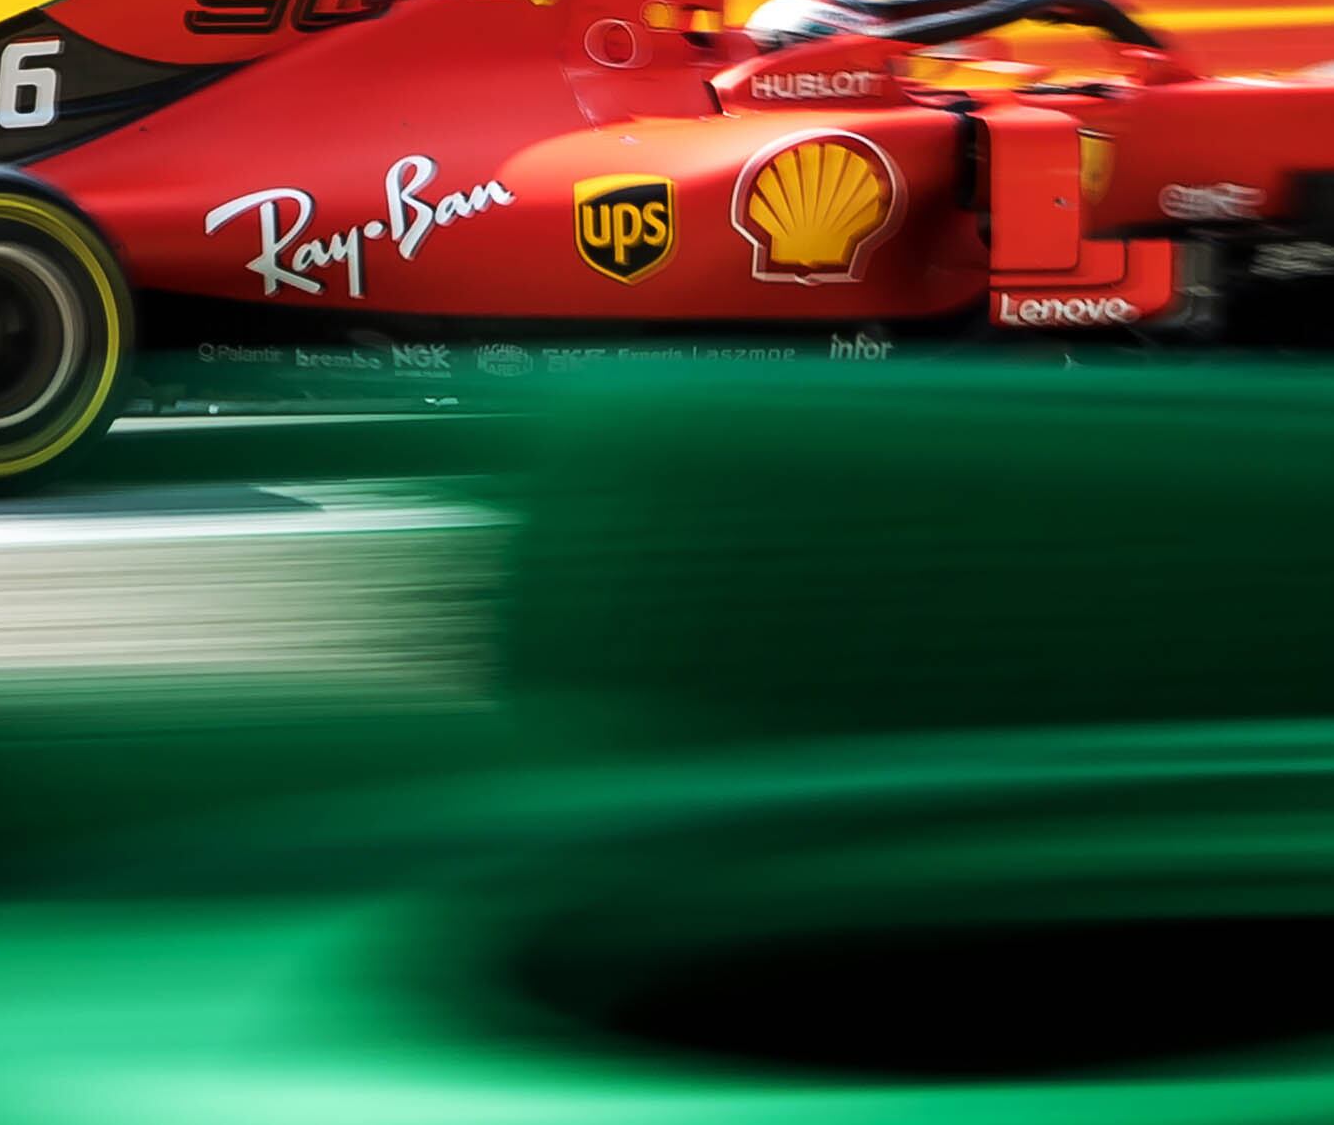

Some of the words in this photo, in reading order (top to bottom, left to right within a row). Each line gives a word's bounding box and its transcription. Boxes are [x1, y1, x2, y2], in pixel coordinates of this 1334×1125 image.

[750, 71, 881, 100] HUBLOT
[998, 292, 1139, 327] Lenovo
[295, 348, 381, 369] brembo
[391, 343, 452, 369] NGK
[829, 333, 893, 362] infor
